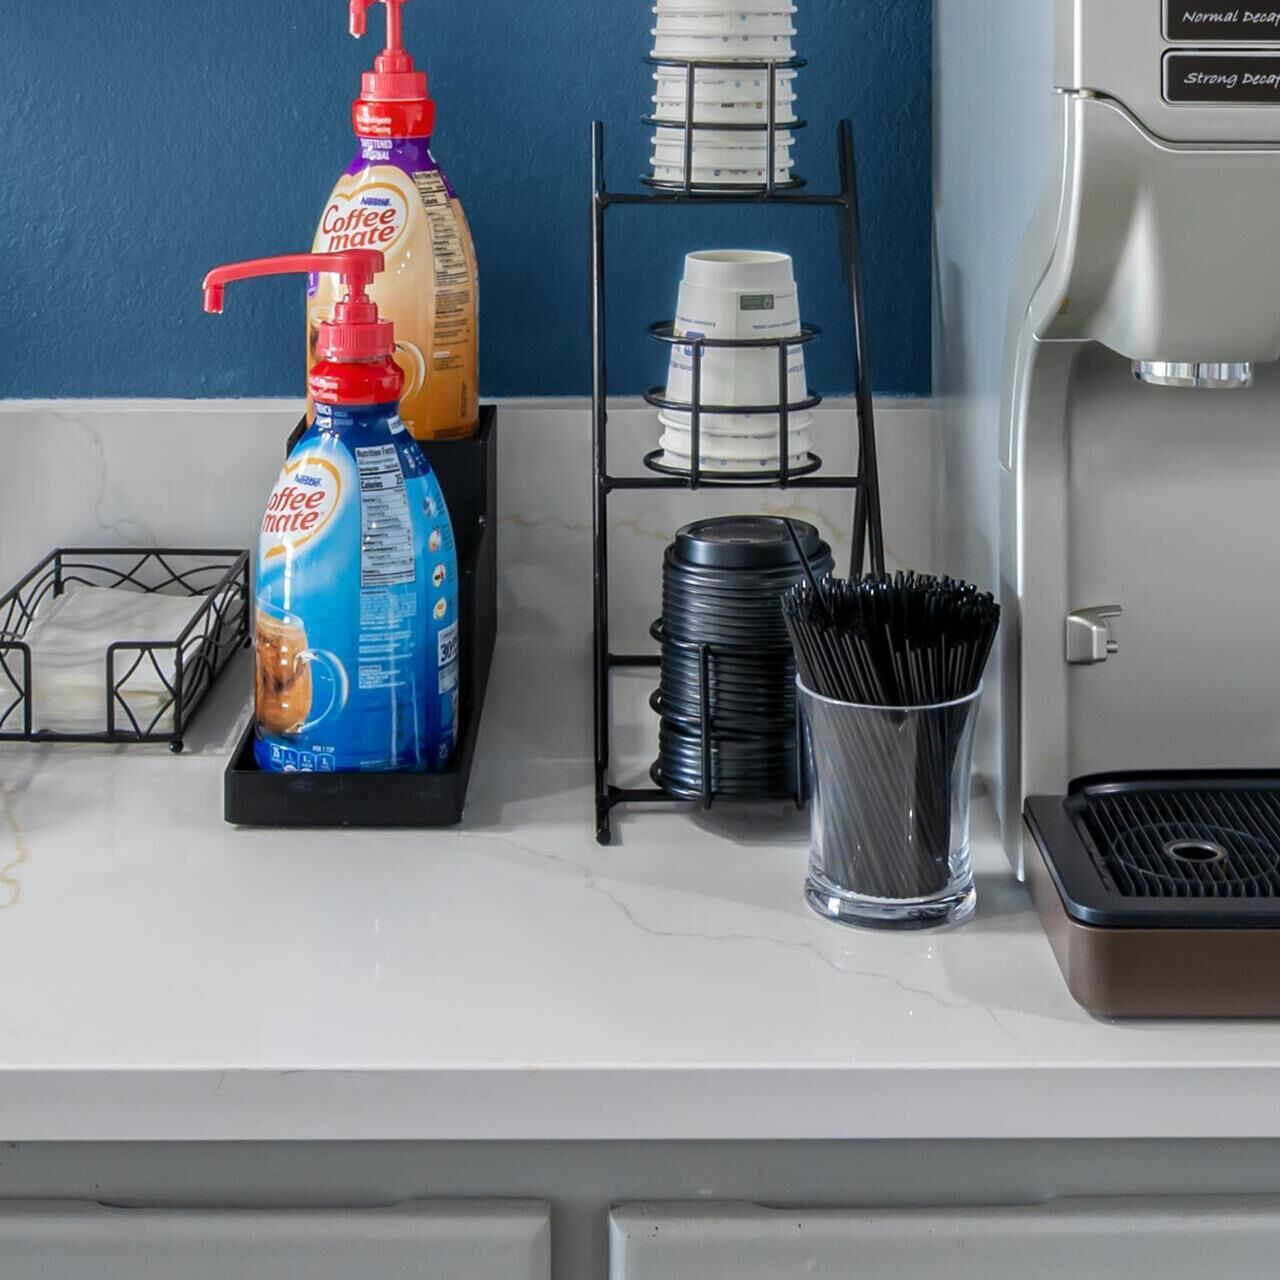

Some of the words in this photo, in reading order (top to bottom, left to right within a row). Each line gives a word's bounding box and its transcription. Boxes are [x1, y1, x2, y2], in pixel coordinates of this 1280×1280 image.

[1182, 9, 1240, 23] Normal
[1183, 72, 1239, 89] Strong
[322, 204, 397, 235] Coffee
[328, 225, 396, 253] mate
[267, 486, 326, 512] offee
[263, 510, 320, 533] mate
